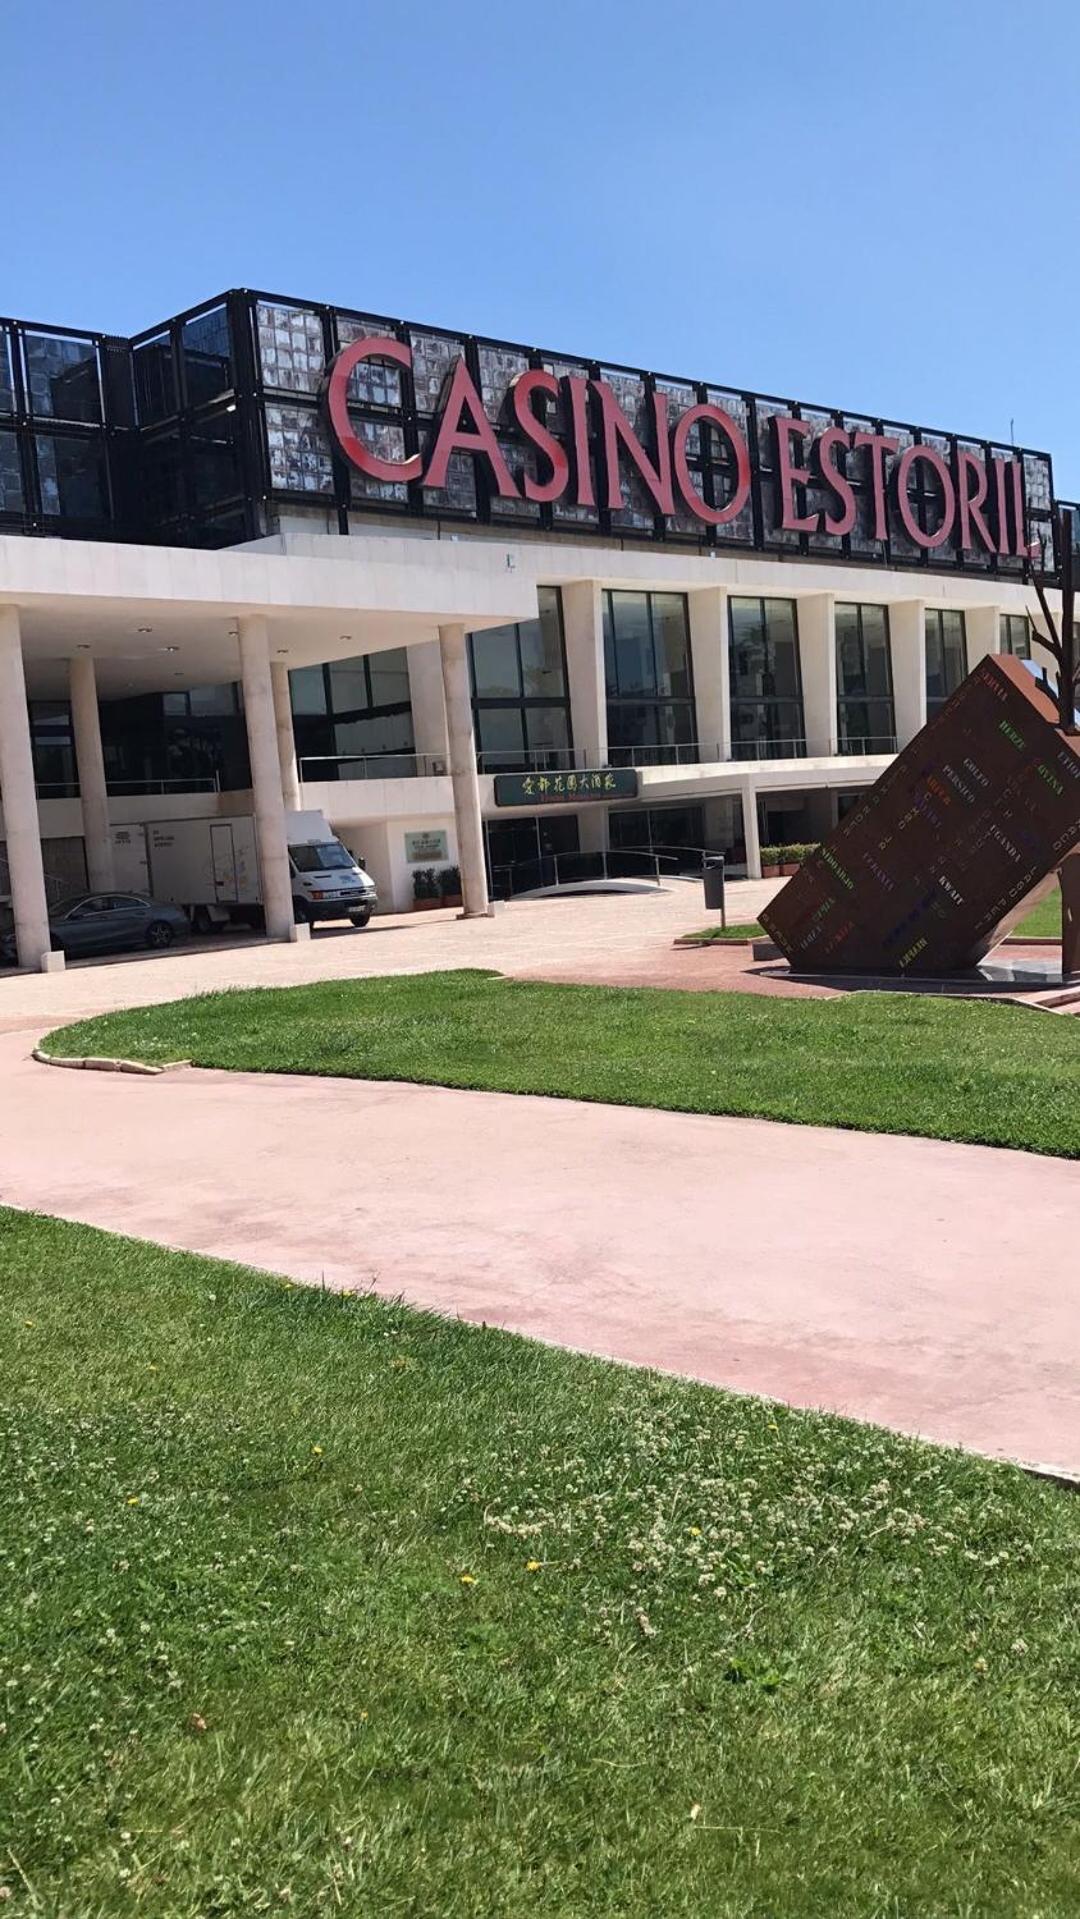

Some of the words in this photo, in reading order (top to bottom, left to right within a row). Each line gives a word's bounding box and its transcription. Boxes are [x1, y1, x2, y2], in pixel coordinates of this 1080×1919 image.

[325, 336, 752, 525] CASINO
[773, 415, 1041, 559] ESTORIL
[942, 764, 976, 803] PERSICO
[989, 823, 1022, 864] UGANDA
[938, 875, 965, 906] KWAIT
